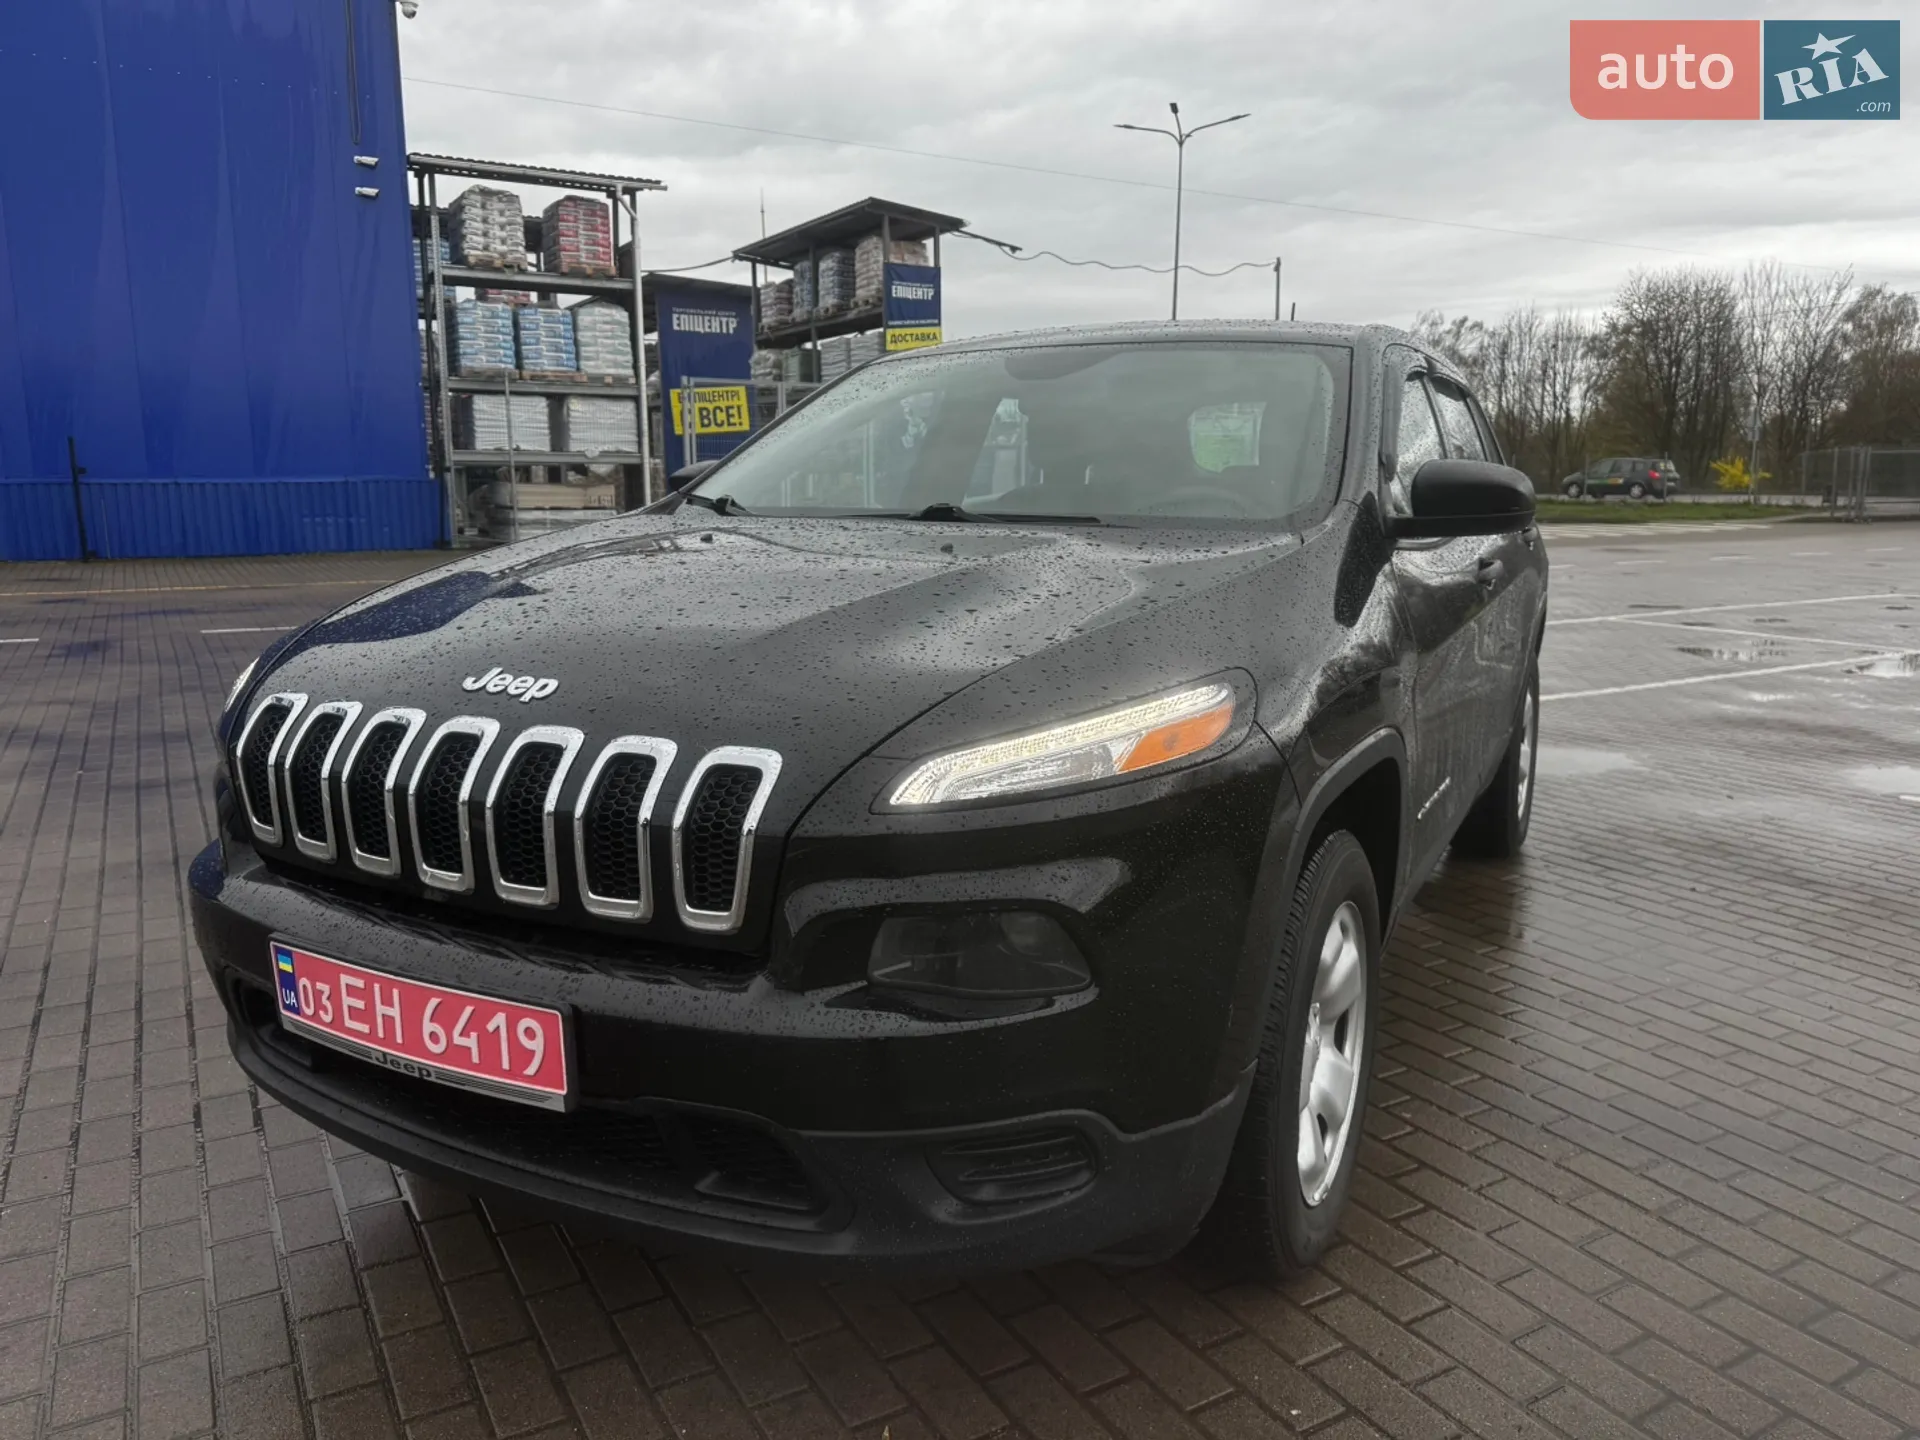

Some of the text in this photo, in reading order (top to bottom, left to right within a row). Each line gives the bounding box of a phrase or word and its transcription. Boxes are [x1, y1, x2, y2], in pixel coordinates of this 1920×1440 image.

[891, 285, 935, 300] ЕПІЦЕНТР
[672, 313, 738, 334] ЕПІЦЕНТР
[890, 332, 938, 344] ДОСТАВКА
[698, 404, 743, 428] ВСЕ!
[462, 667, 559, 703] Jeep
[282, 988, 298, 1007] UA
[422, 997, 545, 1076] 6419
[375, 1053, 432, 1080] Jeep
